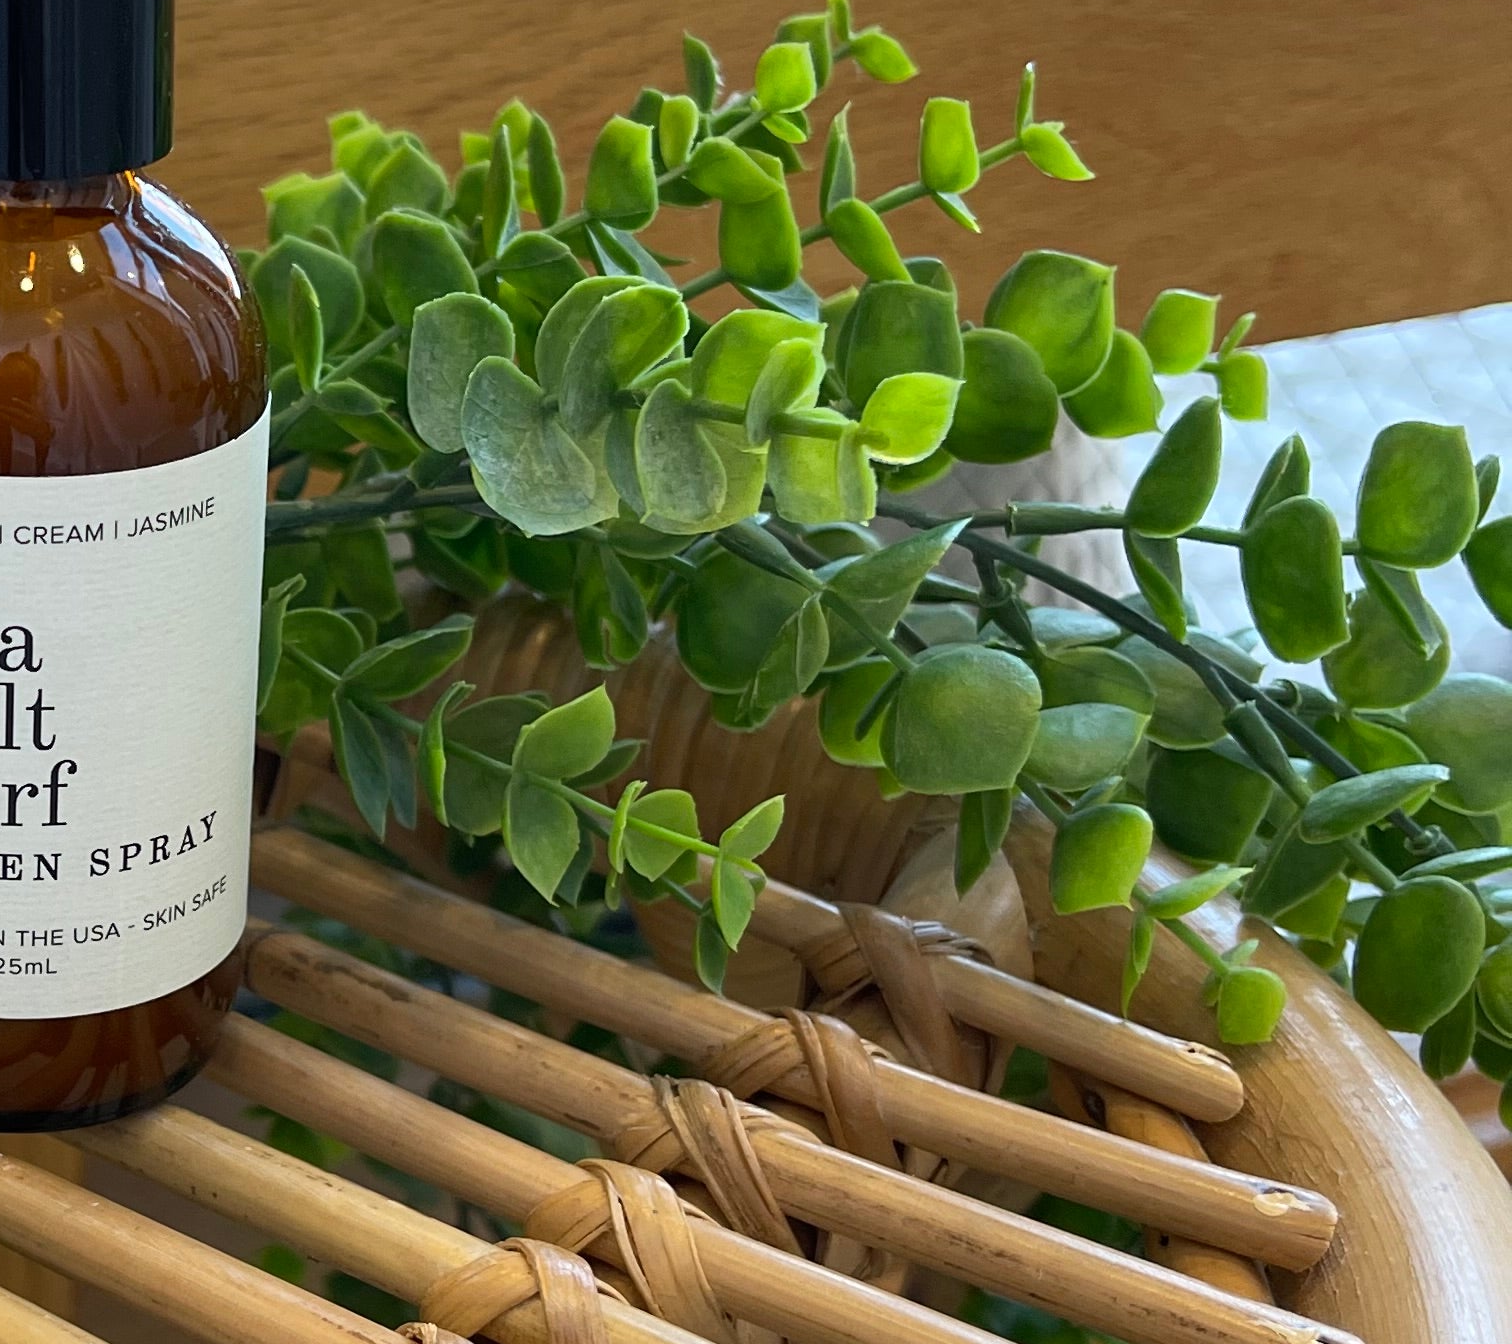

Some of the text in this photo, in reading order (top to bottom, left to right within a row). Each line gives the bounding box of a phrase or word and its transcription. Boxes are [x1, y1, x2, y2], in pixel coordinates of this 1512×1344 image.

[13, 522, 104, 546] CREAM
[126, 495, 215, 538] JASMINE
[89, 810, 218, 878] SPRAY
[15, 928, 65, 948] THE
[73, 922, 121, 945] USA
[142, 900, 187, 932] SKIN
[191, 874, 228, 913] SAFE
